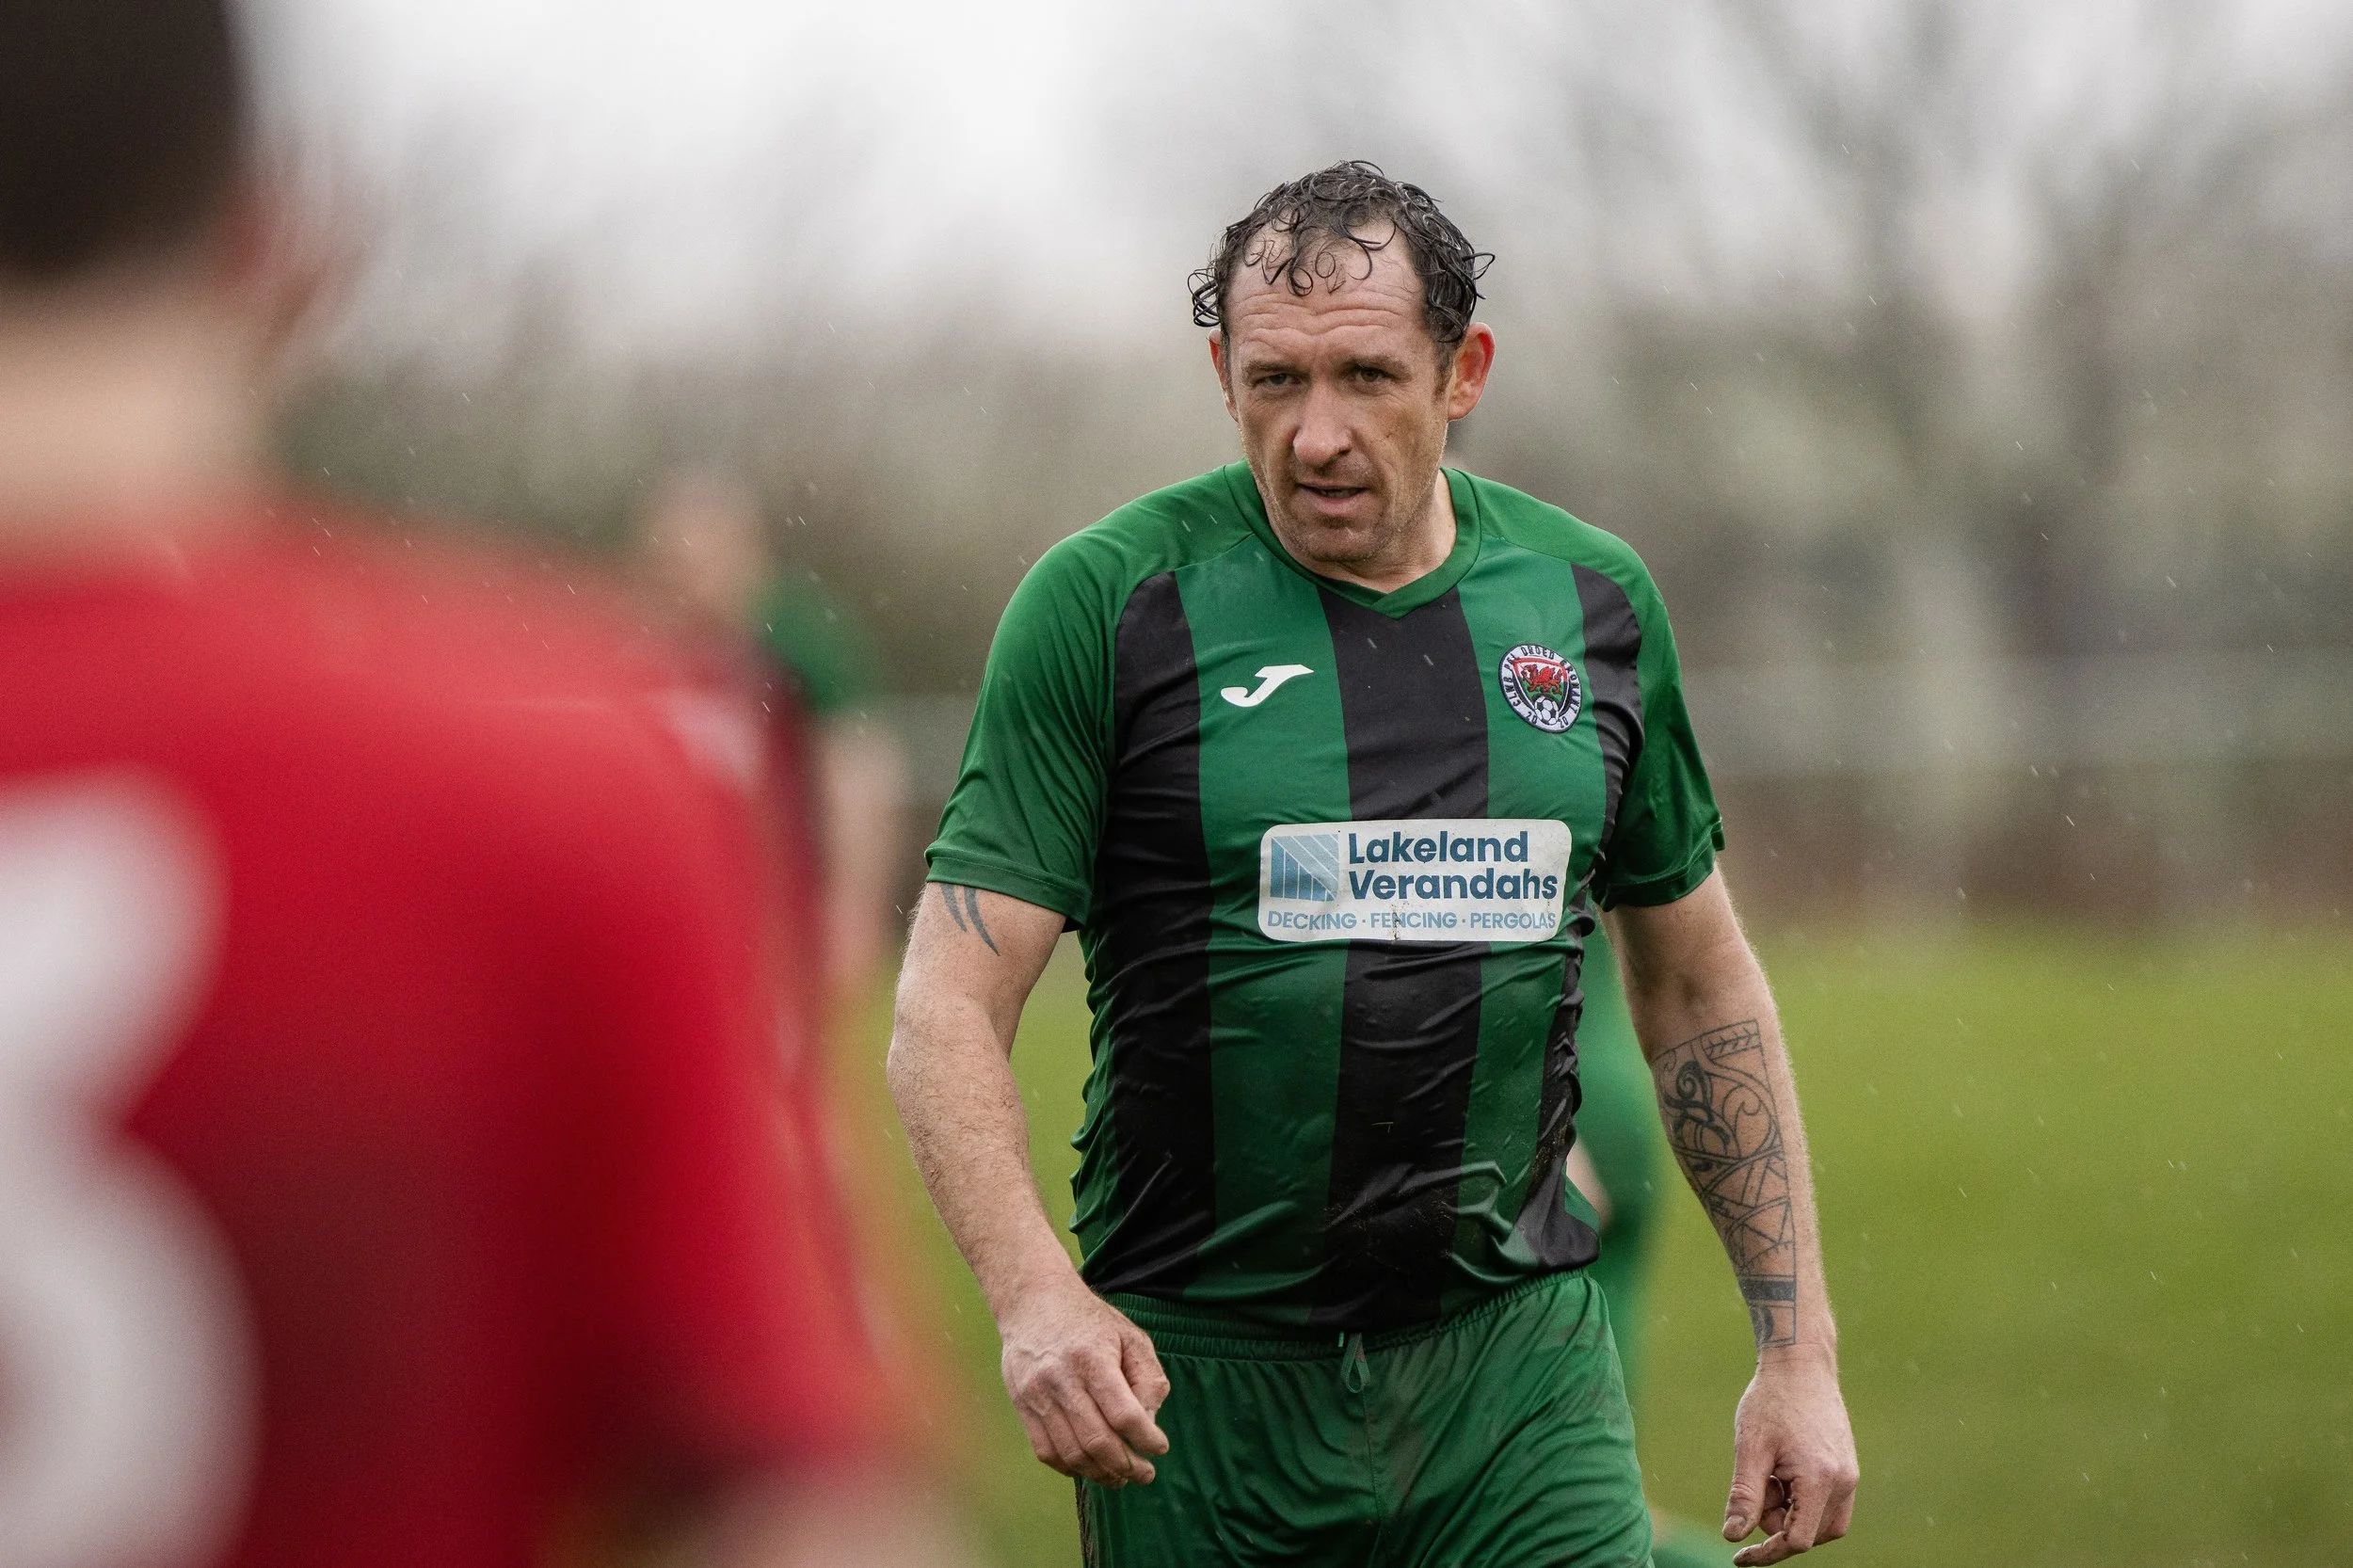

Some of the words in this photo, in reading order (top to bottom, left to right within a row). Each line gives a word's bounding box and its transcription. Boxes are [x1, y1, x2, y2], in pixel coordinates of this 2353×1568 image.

[1520, 646, 1556, 660] DROED
[1526, 712, 1538, 725] 20
[1559, 717, 1569, 728] 20
[1348, 831, 1529, 864] Lakeland
[1348, 868, 1559, 900] Verandahs
[1267, 910, 1357, 931] DECKING
[1370, 911, 1457, 930] FENCING
[1470, 911, 1557, 930] PERGOLAS
